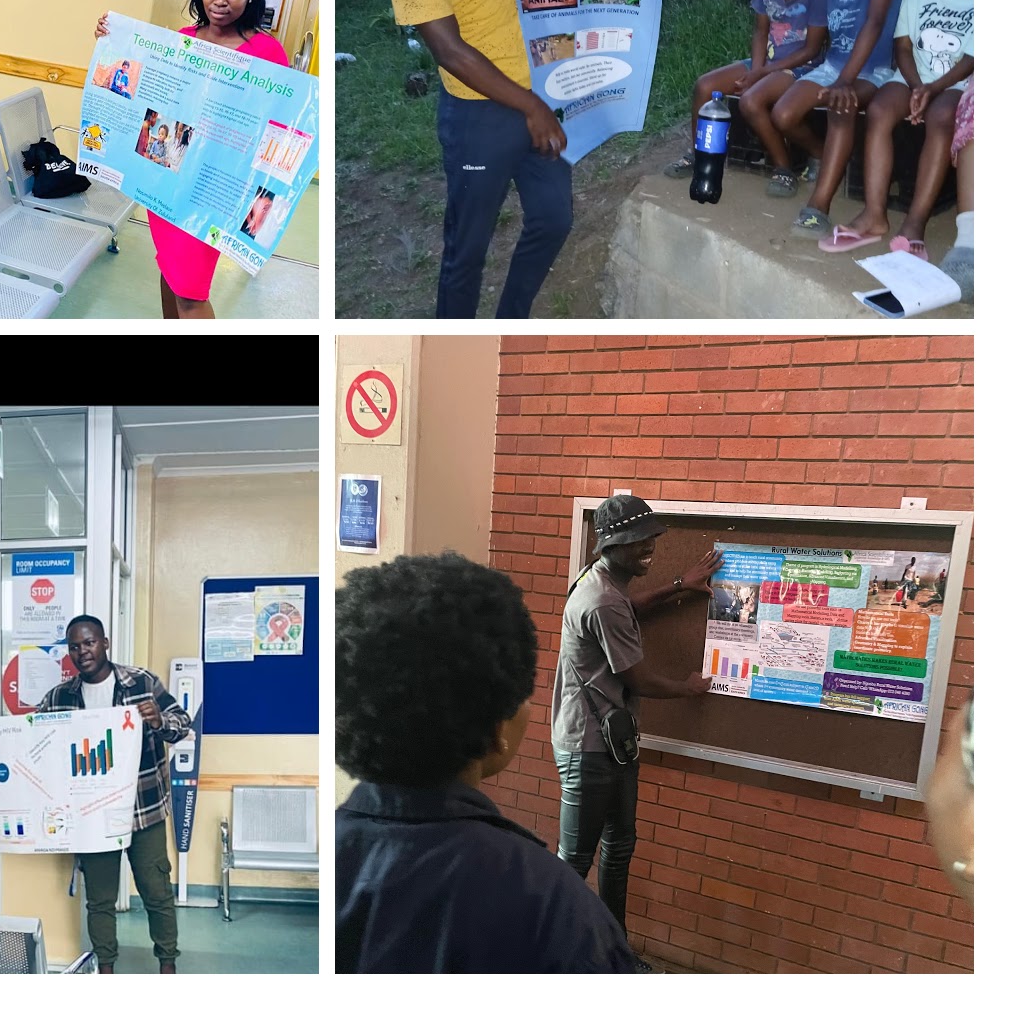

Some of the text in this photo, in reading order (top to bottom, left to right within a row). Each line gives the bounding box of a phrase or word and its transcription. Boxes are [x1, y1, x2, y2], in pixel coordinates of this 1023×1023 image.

[606, 8, 639, 16] GENERATION
[918, 2, 974, 21] Friends
[133, 33, 294, 98] Teenage Pregnancy Analysis
[597, 88, 626, 99] GONG
[704, 124, 713, 149] PEPSI
[79, 161, 99, 175] AIMS
[813, 548, 842, 556] Solutions
[35, 559, 70, 567] OCCUPANCY
[31, 587, 54, 597] STOP
[712, 682, 729, 692] AIMS
[180, 790, 194, 850] HAND SANITISER
